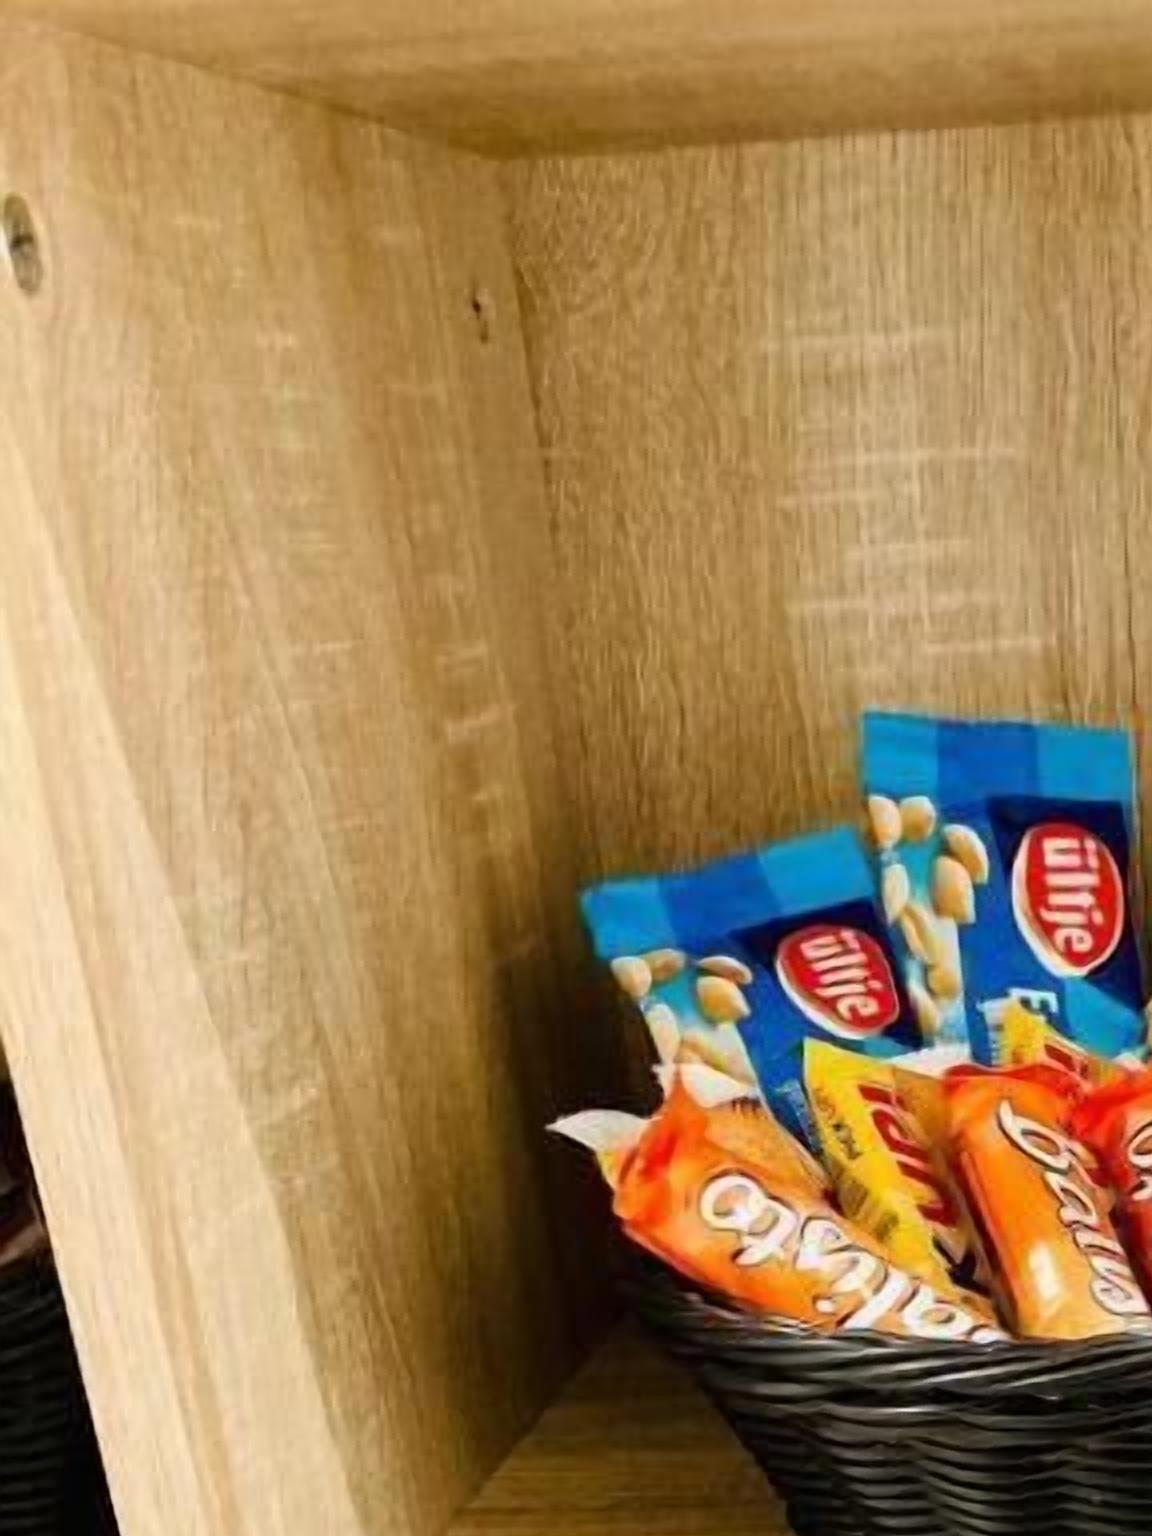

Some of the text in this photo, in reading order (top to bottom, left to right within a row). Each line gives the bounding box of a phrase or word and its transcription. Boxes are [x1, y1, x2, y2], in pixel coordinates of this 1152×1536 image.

[1039, 834, 1100, 958] ültje
[799, 927, 879, 1021] ültje
[700, 1172, 1012, 1342] alisto
